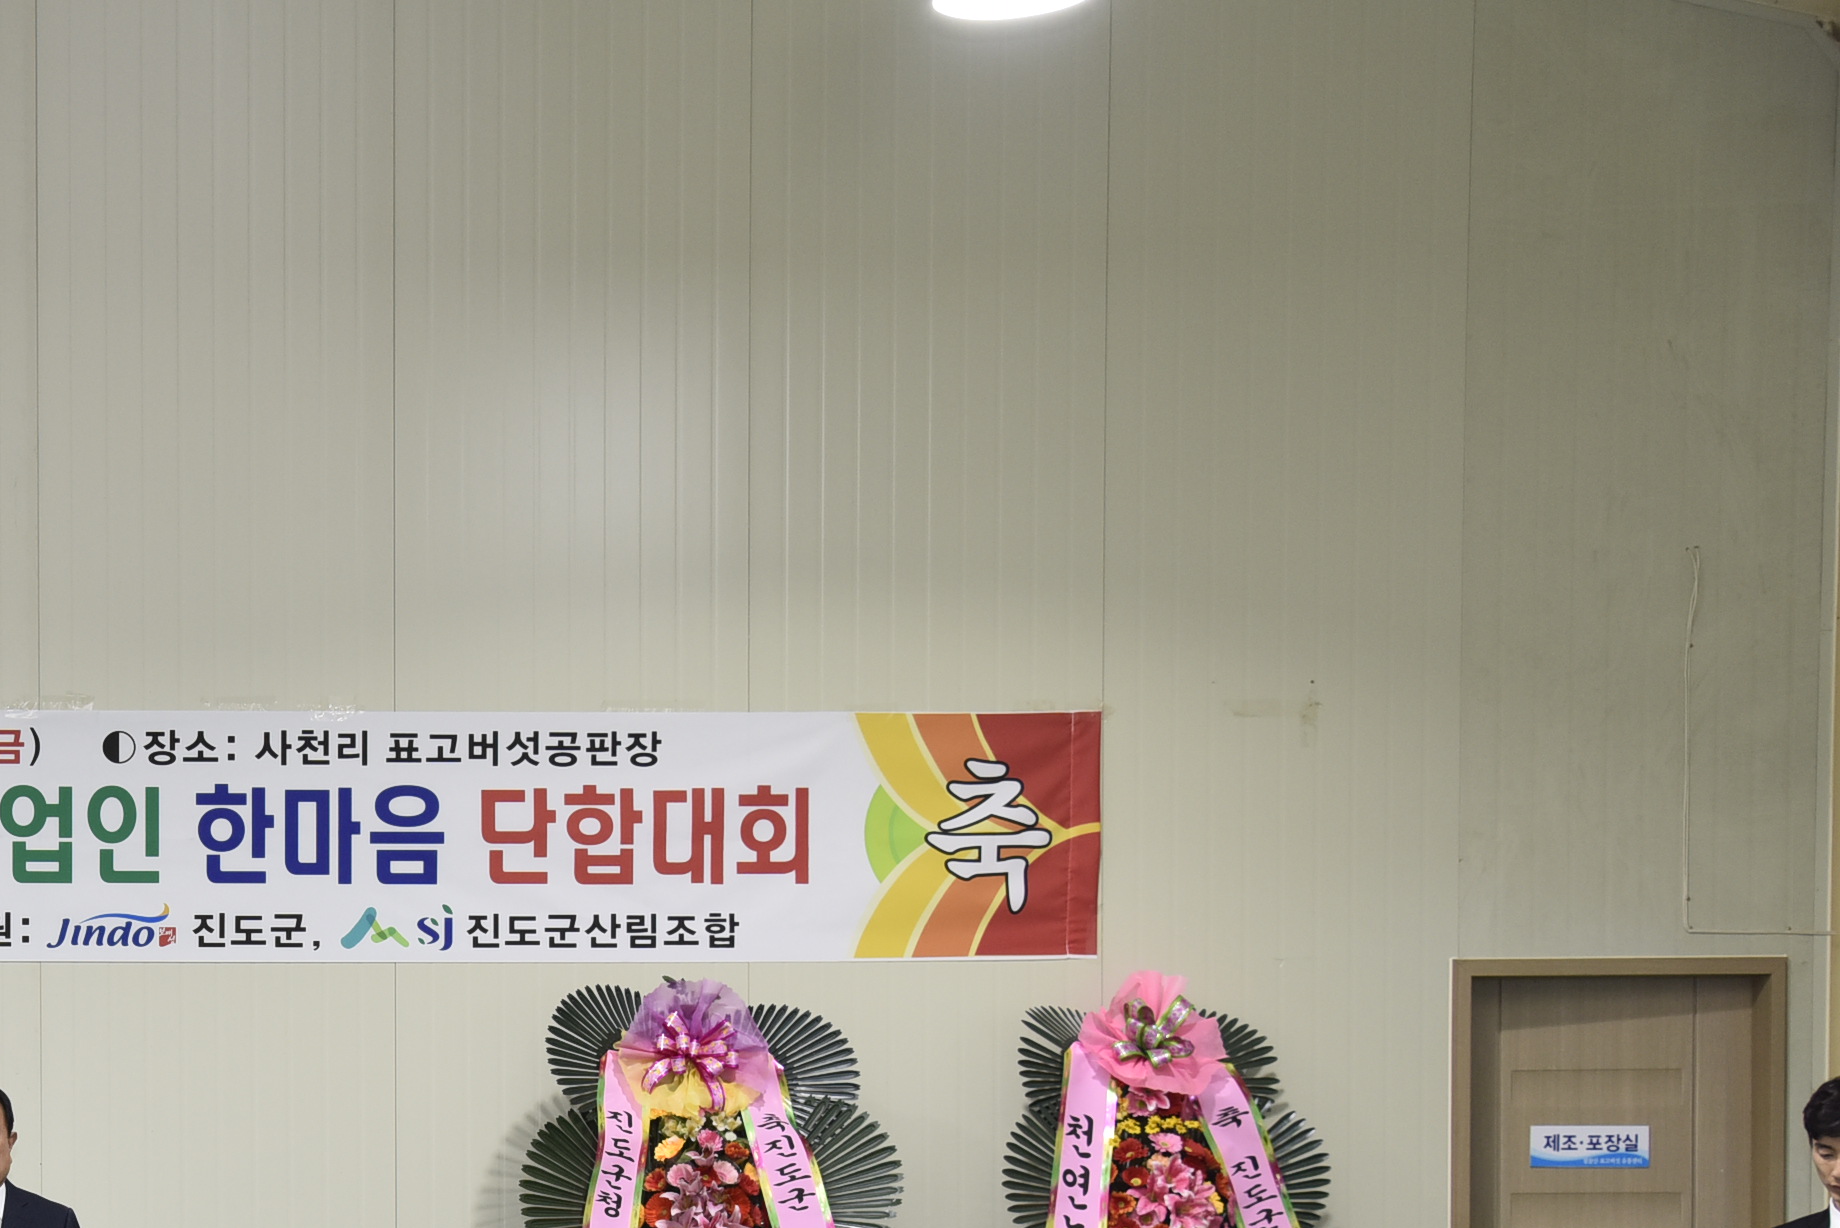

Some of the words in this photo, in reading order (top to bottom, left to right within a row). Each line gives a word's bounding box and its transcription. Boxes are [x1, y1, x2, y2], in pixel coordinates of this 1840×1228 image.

[143, 729, 236, 766] 장소:
[254, 729, 368, 767] 사천리
[385, 730, 662, 768] 표고버섯공판장
[195, 783, 445, 885] 한마음
[480, 784, 810, 885] 단합대회
[923, 757, 1053, 914] 축
[46, 918, 155, 949] Jindo
[192, 912, 321, 951] 진도군,
[466, 913, 740, 949] 진도군산림조합
[1211, 1106, 1250, 1128] 축
[1543, 1133, 1639, 1153] 제조·포장실
[595, 1110, 635, 1218] 진도군청
